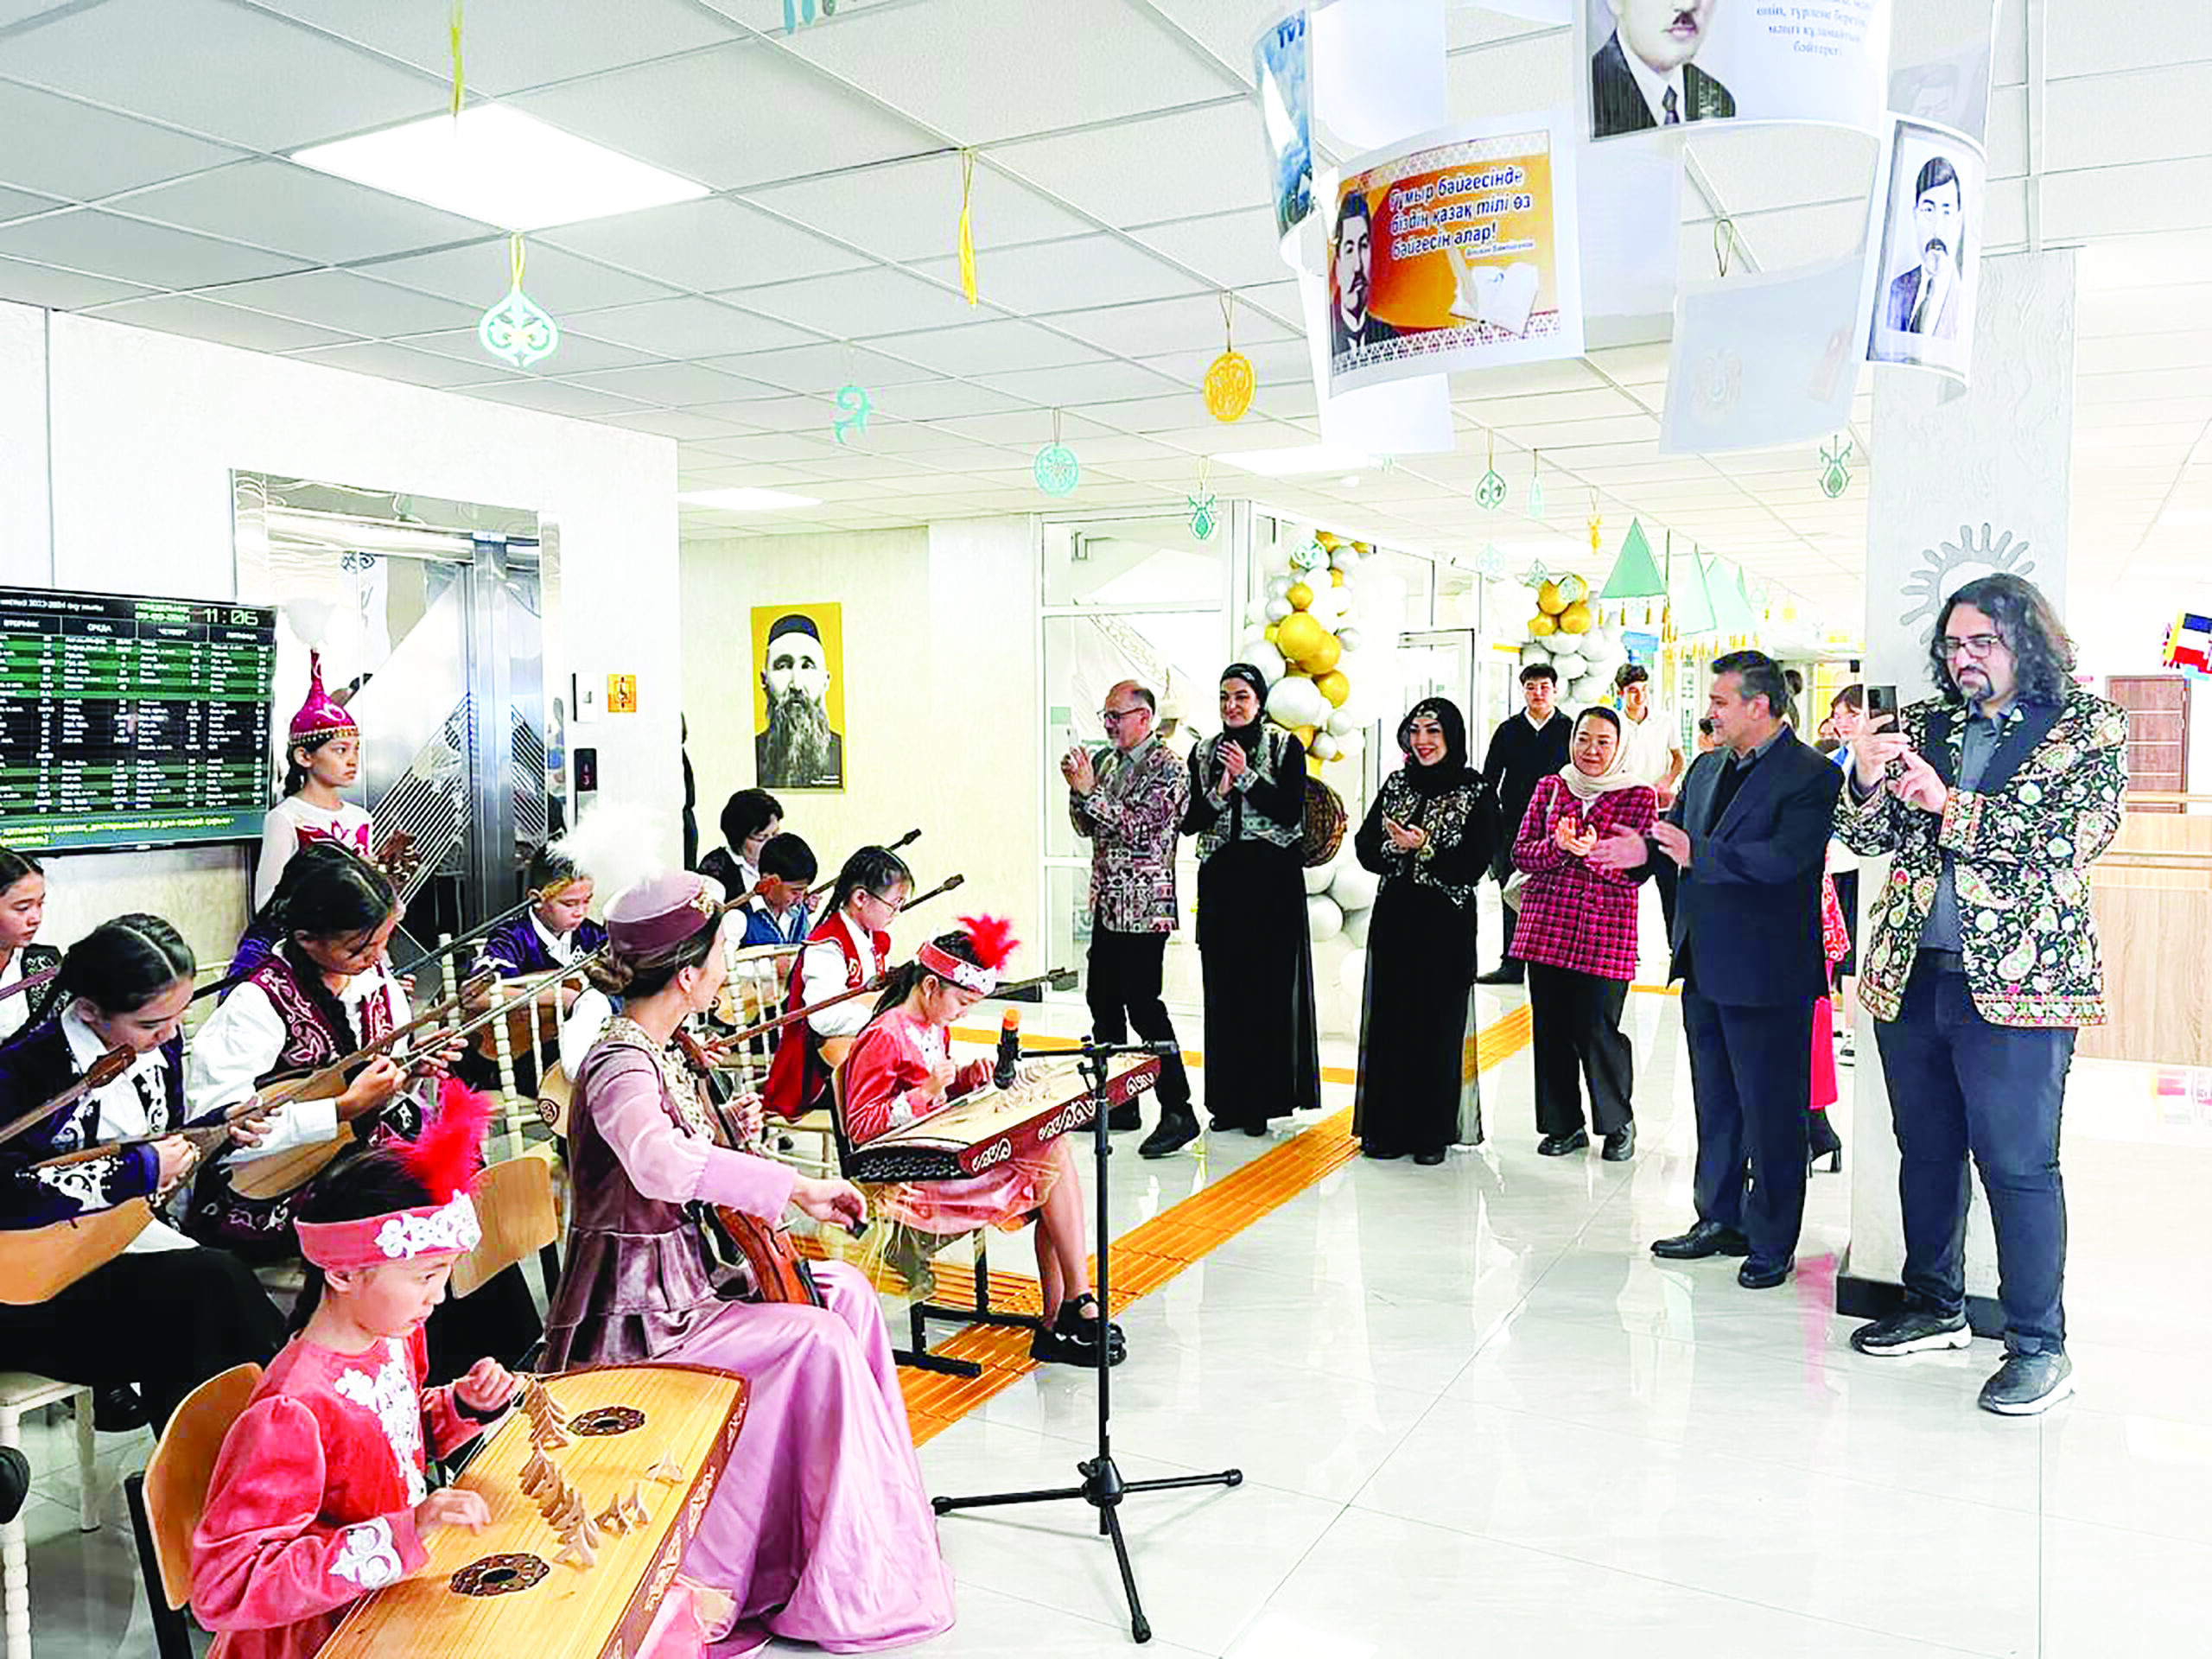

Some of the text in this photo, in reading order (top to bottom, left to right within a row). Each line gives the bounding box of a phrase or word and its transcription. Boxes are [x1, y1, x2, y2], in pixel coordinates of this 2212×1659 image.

[1438, 166, 1523, 197] бәйгесінде
[1476, 196, 1510, 216] тілі
[1512, 194, 1532, 211] өз
[1454, 220, 1497, 245] алар!
